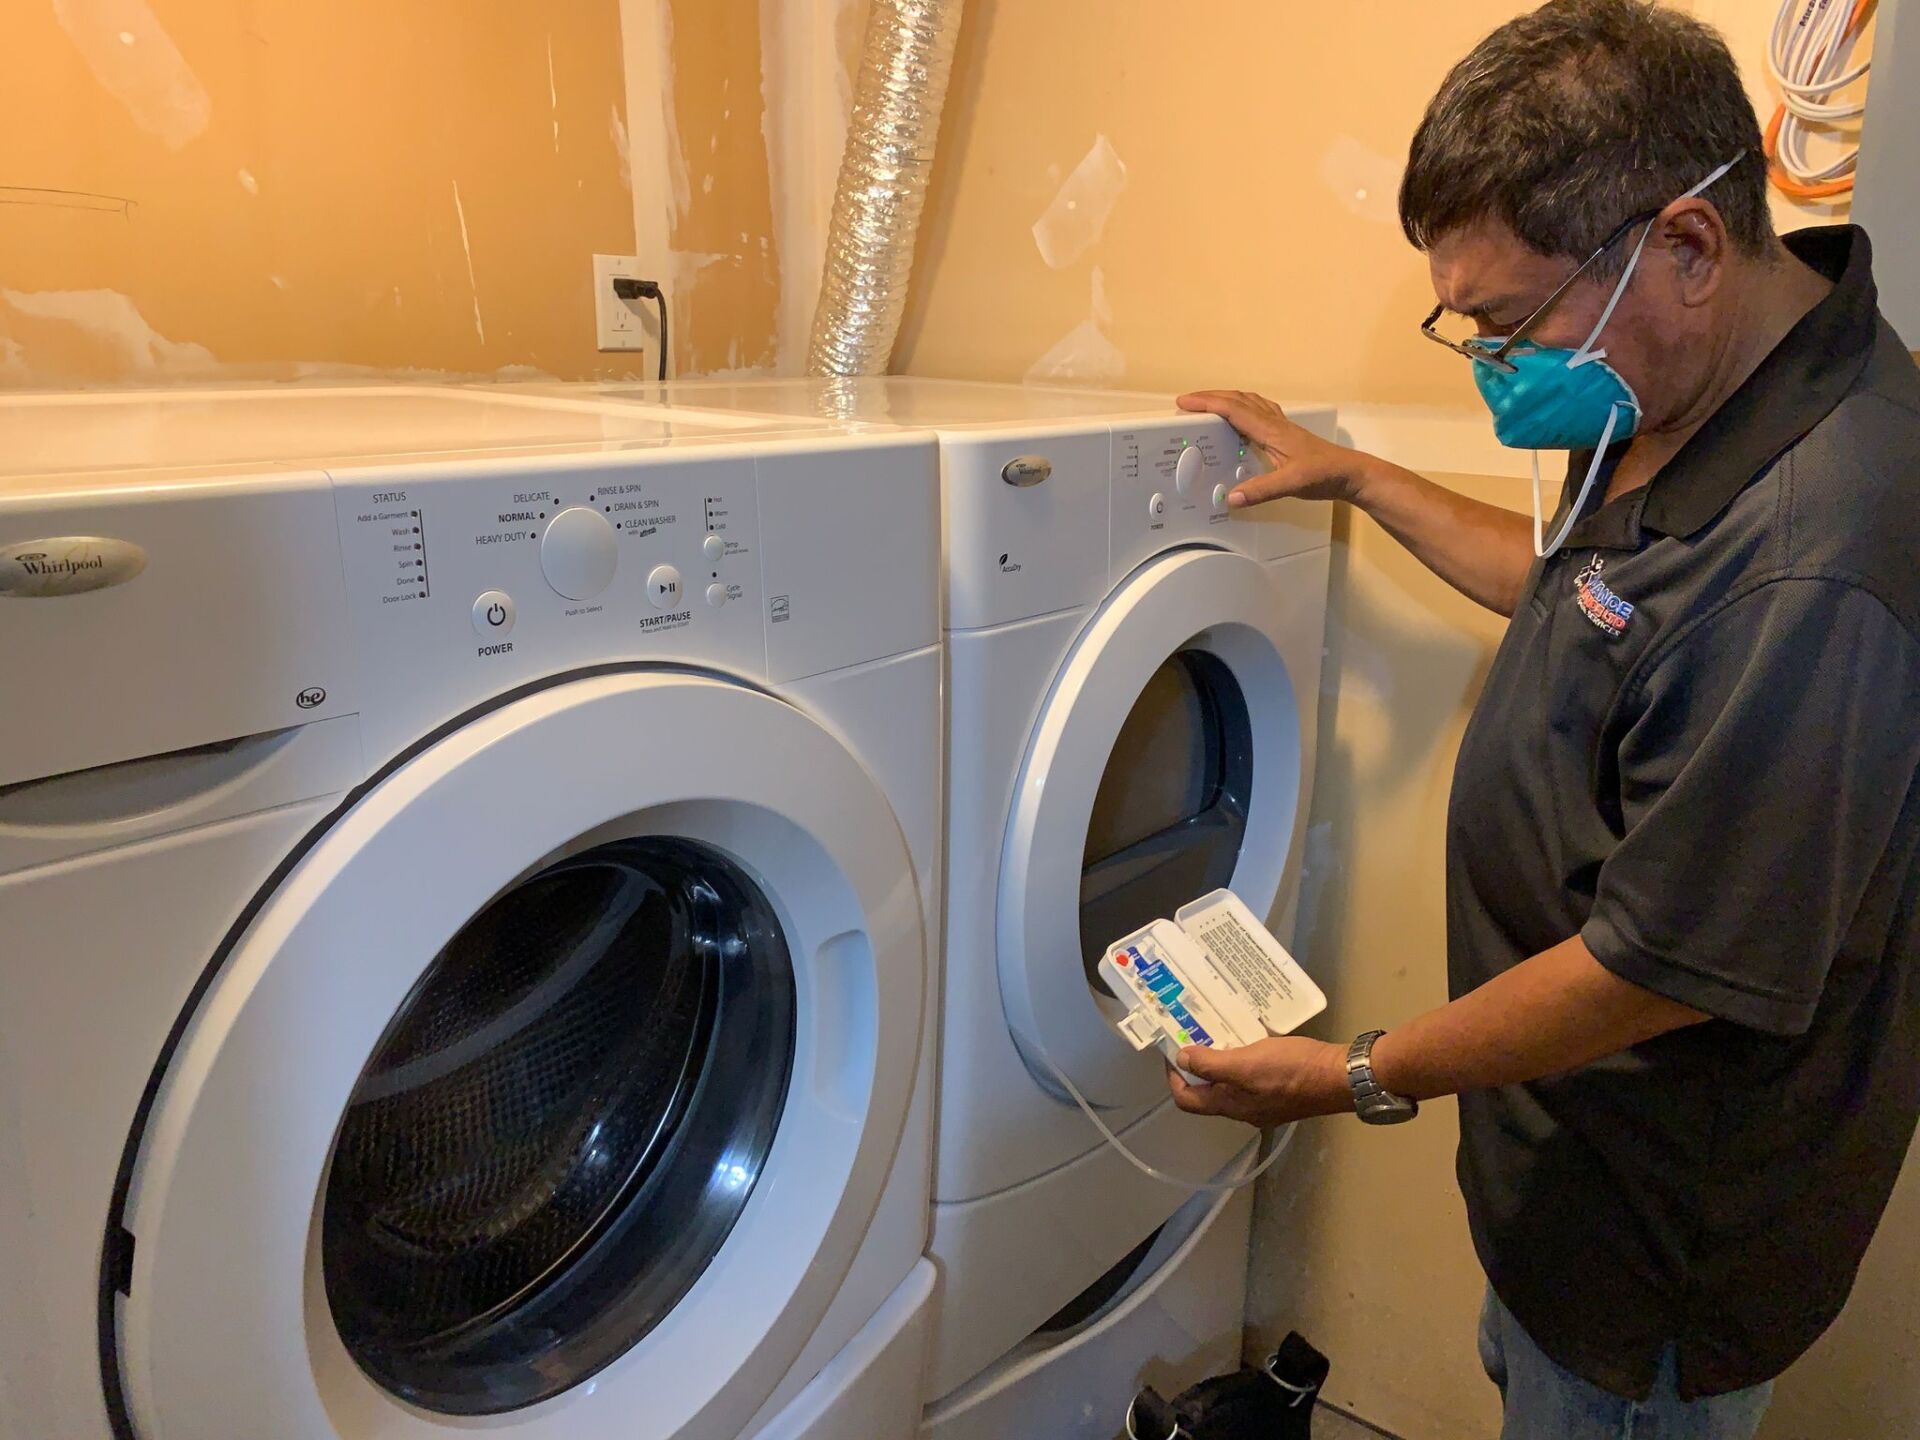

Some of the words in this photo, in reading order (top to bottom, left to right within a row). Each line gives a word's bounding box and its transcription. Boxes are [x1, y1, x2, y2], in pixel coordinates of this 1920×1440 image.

[597, 487, 618, 496] RINSE
[626, 484, 641, 493] SPIN
[372, 491, 407, 504] STATUS
[513, 491, 551, 503] DELICATE
[614, 502, 637, 512] DRAIN
[643, 499, 660, 509] SPIN
[498, 511, 536, 523] NORMAL
[624, 518, 648, 529] CLEAN
[648, 514, 676, 526] WASHER
[391, 527, 411, 536] Wash
[475, 534, 503, 545] HEAVY
[504, 531, 527, 542] DUTY
[21, 554, 104, 576] Whirlpool
[396, 577, 416, 586] Done
[639, 610, 691, 628] START/PAUSE
[477, 642, 513, 657] POWER
